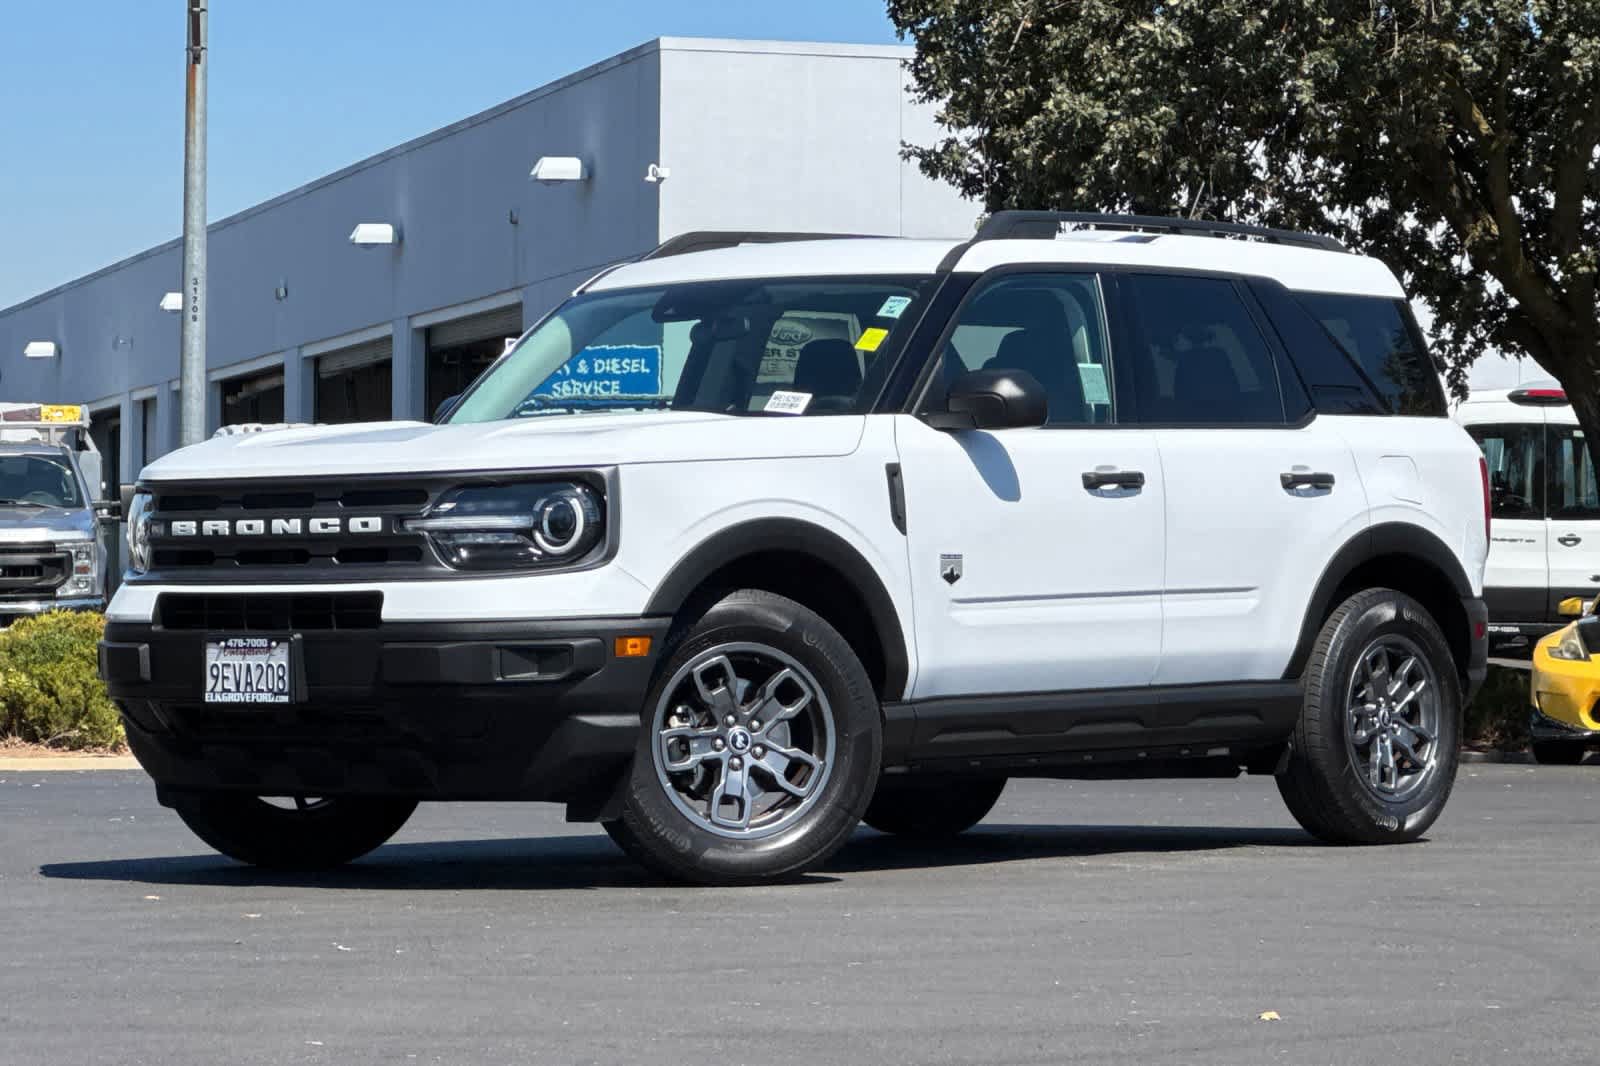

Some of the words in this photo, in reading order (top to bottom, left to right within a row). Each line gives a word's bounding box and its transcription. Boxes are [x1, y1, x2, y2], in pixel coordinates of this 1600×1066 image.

[576, 358, 590, 375] &
[593, 357, 651, 374] DIESEL
[551, 379, 621, 397] SERVICE
[171, 516, 382, 536] BRONCO
[210, 662, 287, 693] 9EVA208
